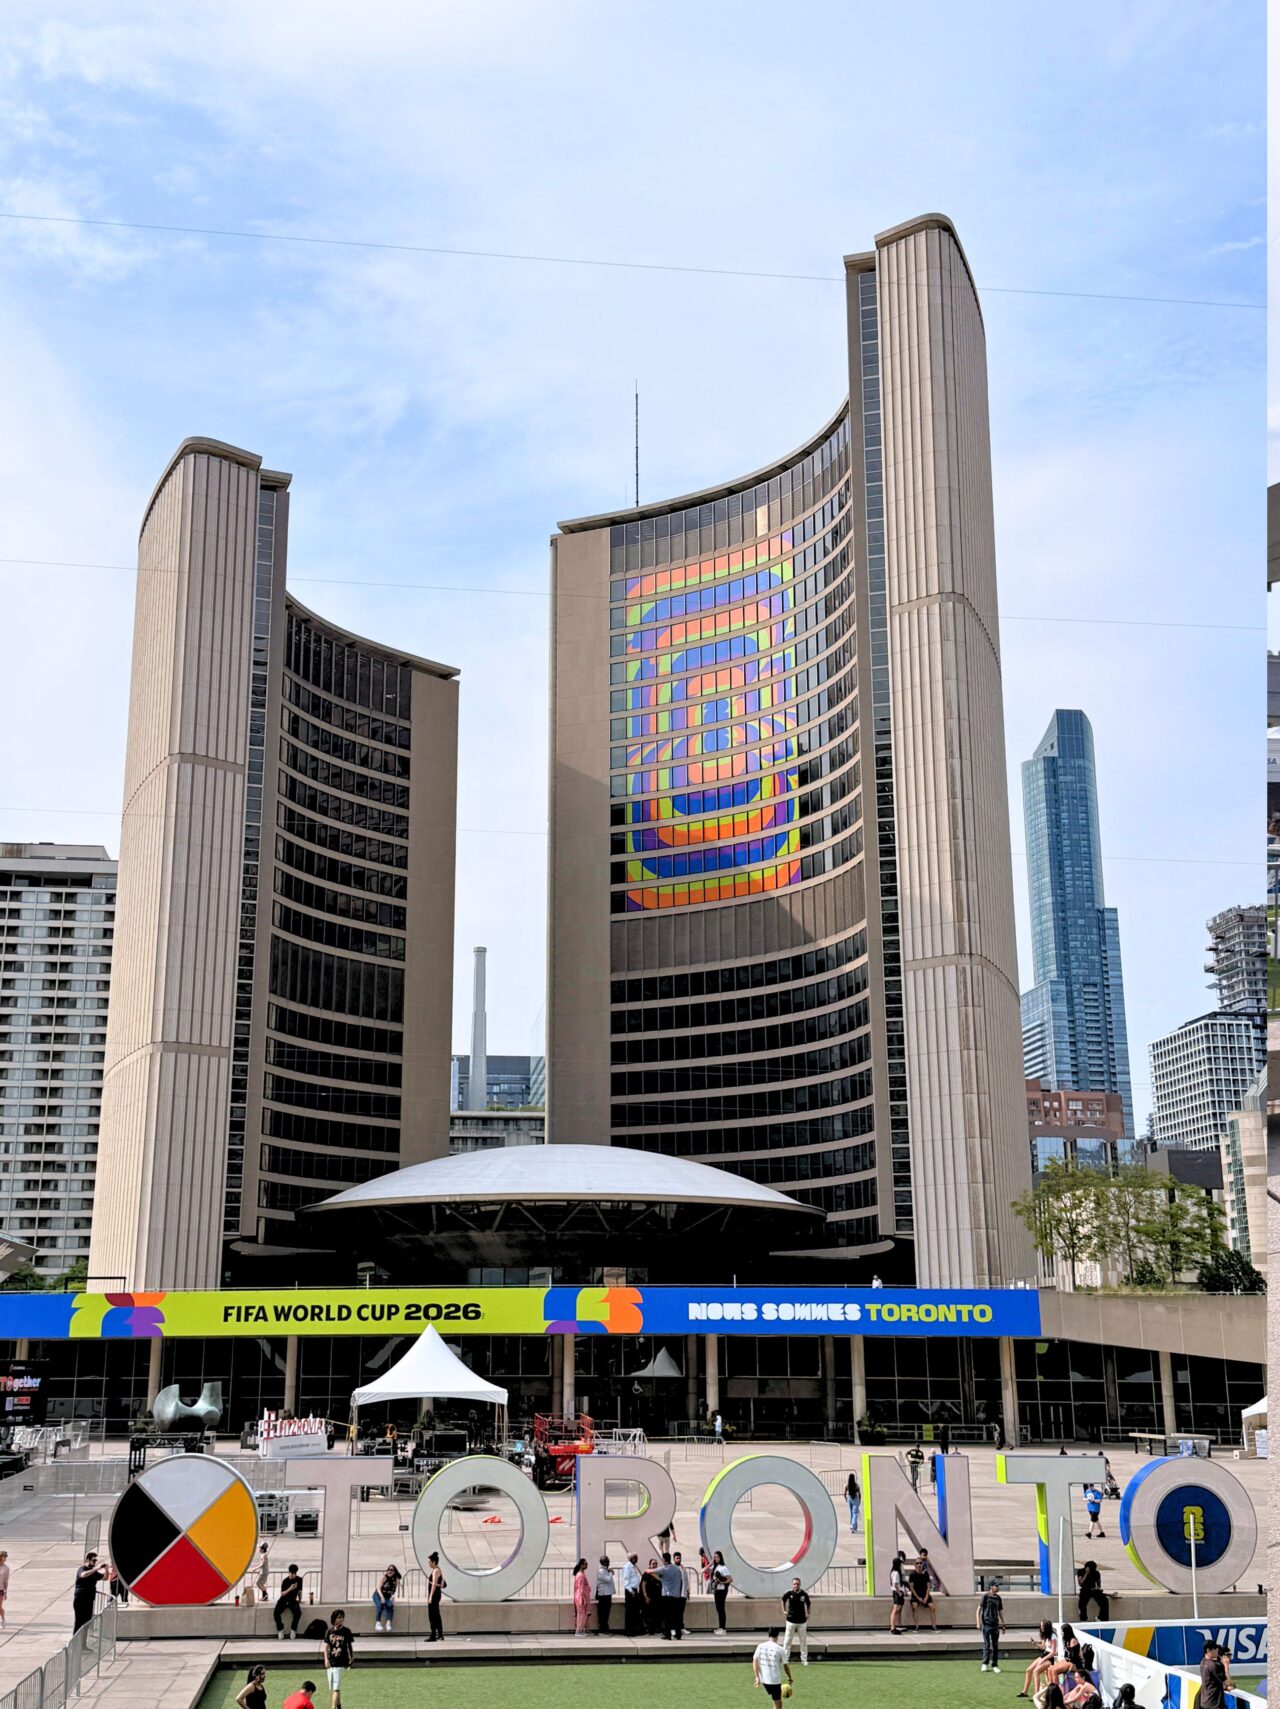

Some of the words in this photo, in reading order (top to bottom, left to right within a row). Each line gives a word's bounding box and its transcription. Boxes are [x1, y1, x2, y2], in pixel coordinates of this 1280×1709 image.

[223, 1305, 269, 1322] FIFA
[272, 1304, 352, 1322] WORLD
[356, 1303, 400, 1321] CUP
[404, 1303, 481, 1321] 2026
[761, 1303, 862, 1321] SOMMES
[865, 1303, 993, 1323] TORONTO
[284, 1453, 1258, 1605] TORONTO
